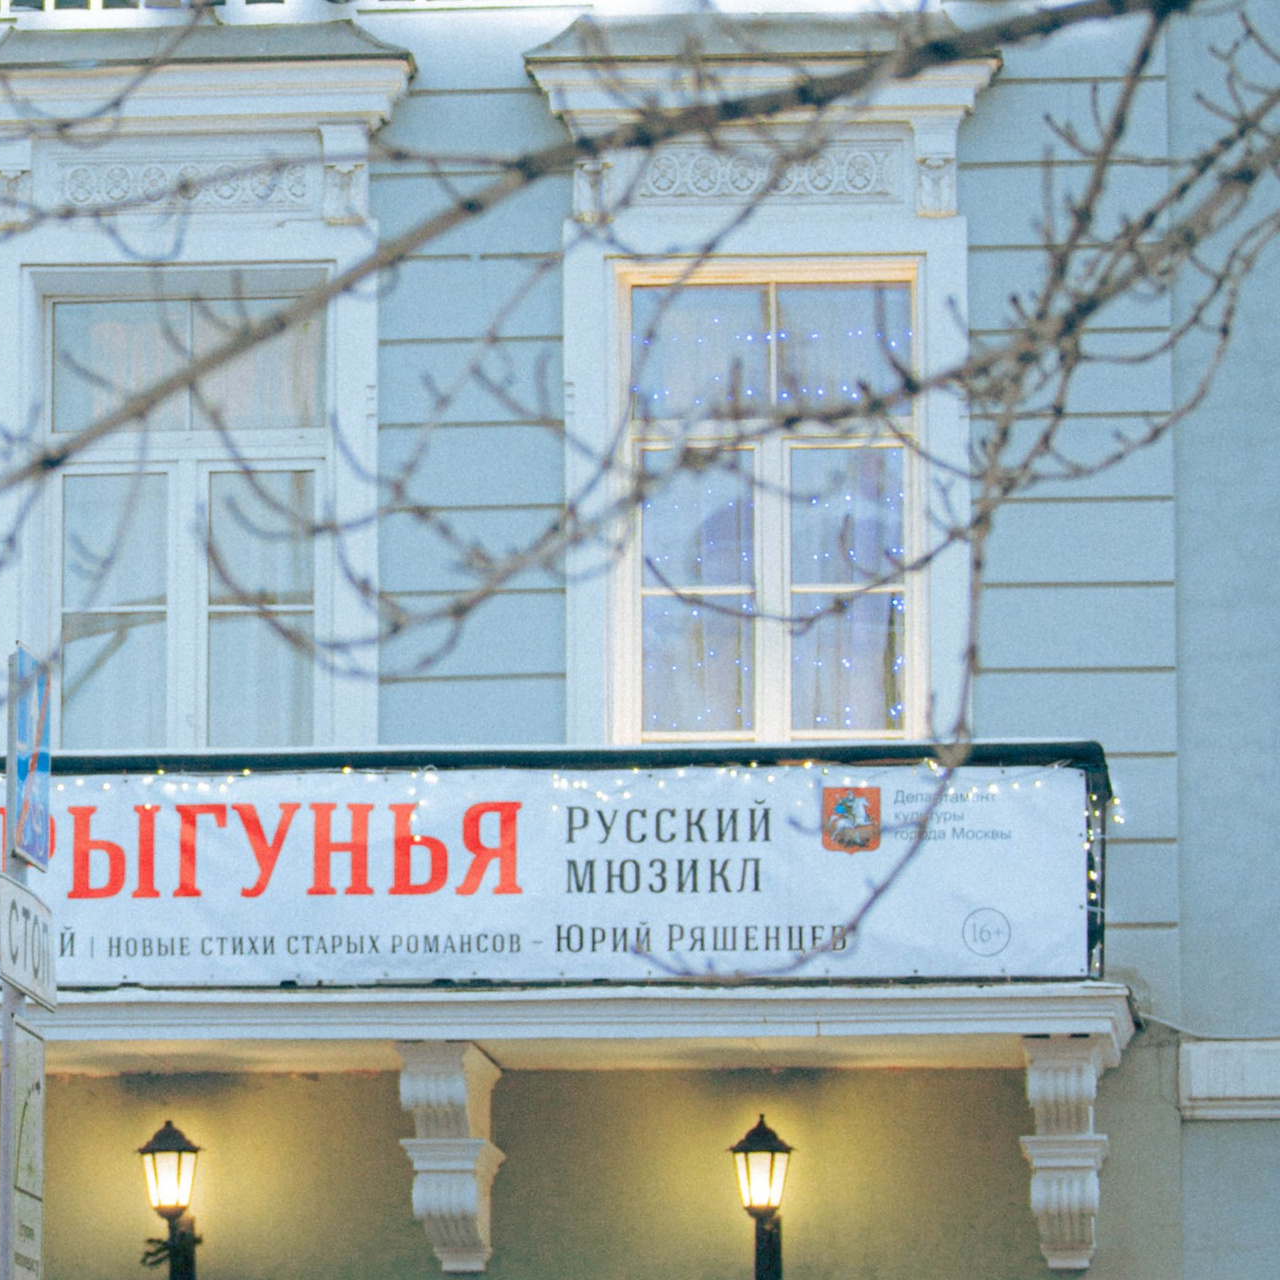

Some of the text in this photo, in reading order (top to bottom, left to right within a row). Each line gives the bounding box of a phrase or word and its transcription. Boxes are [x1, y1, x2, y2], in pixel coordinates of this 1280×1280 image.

[565, 800, 773, 844] РУССКИЙ
[952, 827, 1011, 840] Москвы
[565, 857, 762, 894] МЮЗИКЛ
[108, 935, 191, 957] НОВЫЕ
[201, 934, 276, 957] СТИХИ
[286, 933, 380, 956] СТАРЫХ
[391, 931, 522, 955] РОМАНСОВ
[556, 920, 652, 953] ЮРИЙ
[667, 922, 848, 957] РЯШЕНЦЕВ
[972, 922, 1003, 943] 16+
